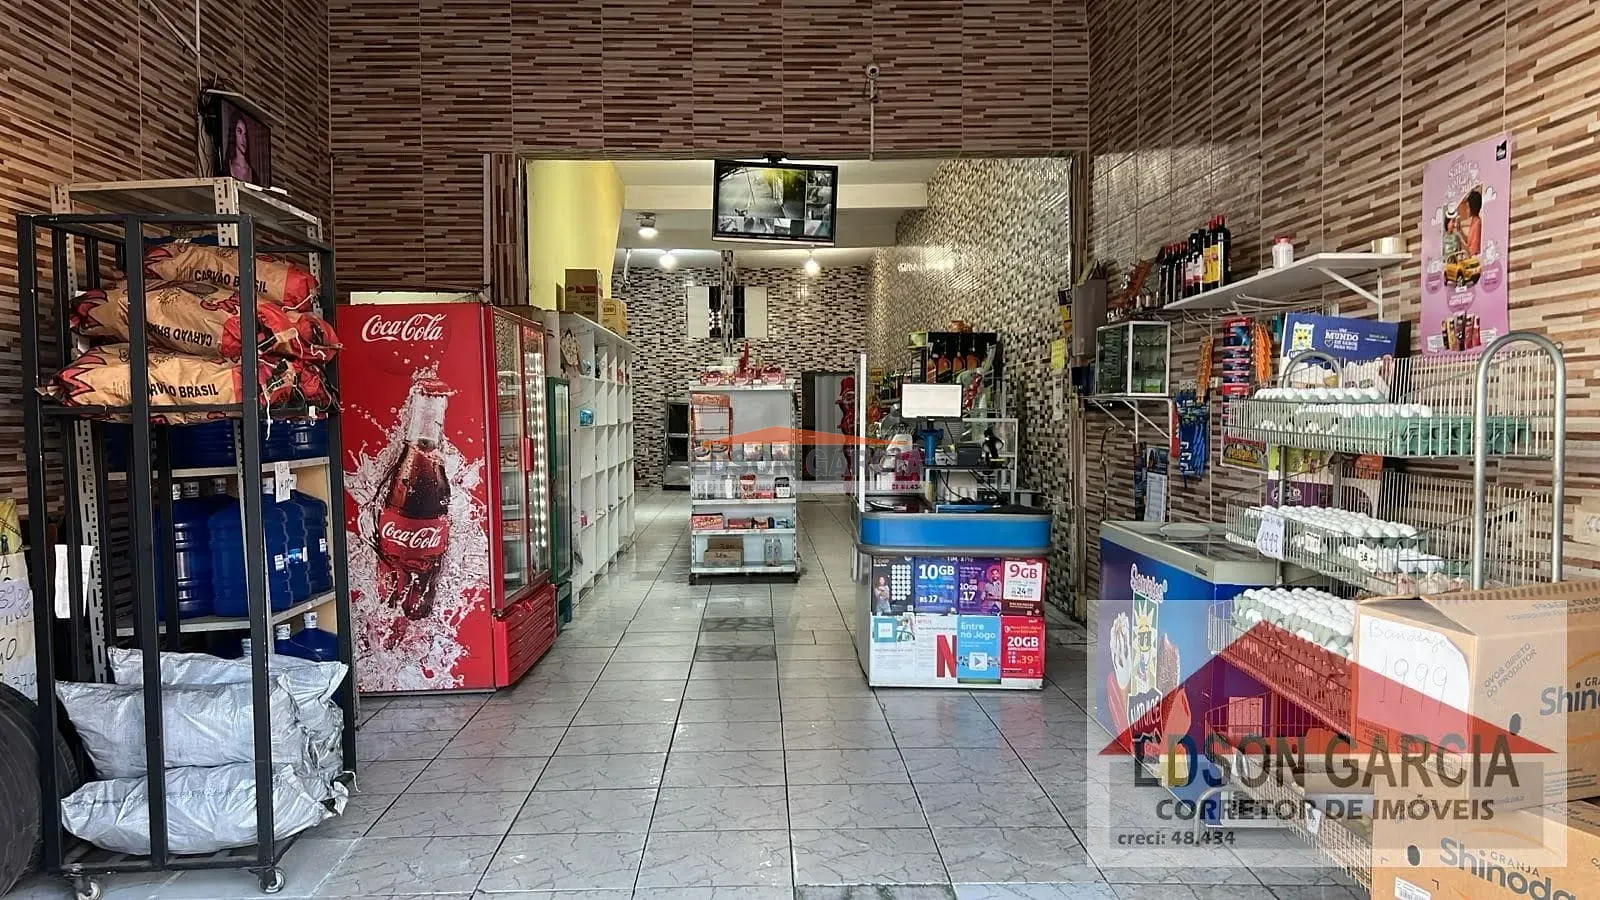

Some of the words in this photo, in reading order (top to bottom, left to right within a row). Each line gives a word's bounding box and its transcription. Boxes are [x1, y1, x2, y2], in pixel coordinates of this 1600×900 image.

[194, 269, 231, 286] CARVÃO
[361, 313, 447, 342] Coca-Cola
[1325, 330, 1359, 341] MUNDO
[179, 383, 219, 398] BRASIL
[381, 521, 444, 549] Coca-Cola
[1009, 564, 1038, 579] 9GB
[961, 622, 985, 630] Entre
[974, 631, 996, 640] Jogo
[1007, 637, 1039, 647] 20GB
[1505, 643, 1531, 669] DIRETO
[1498, 649, 1538, 687] PRODUTOR
[1540, 686, 1600, 716] Shin
[1490, 851, 1541, 878] GRANJA
